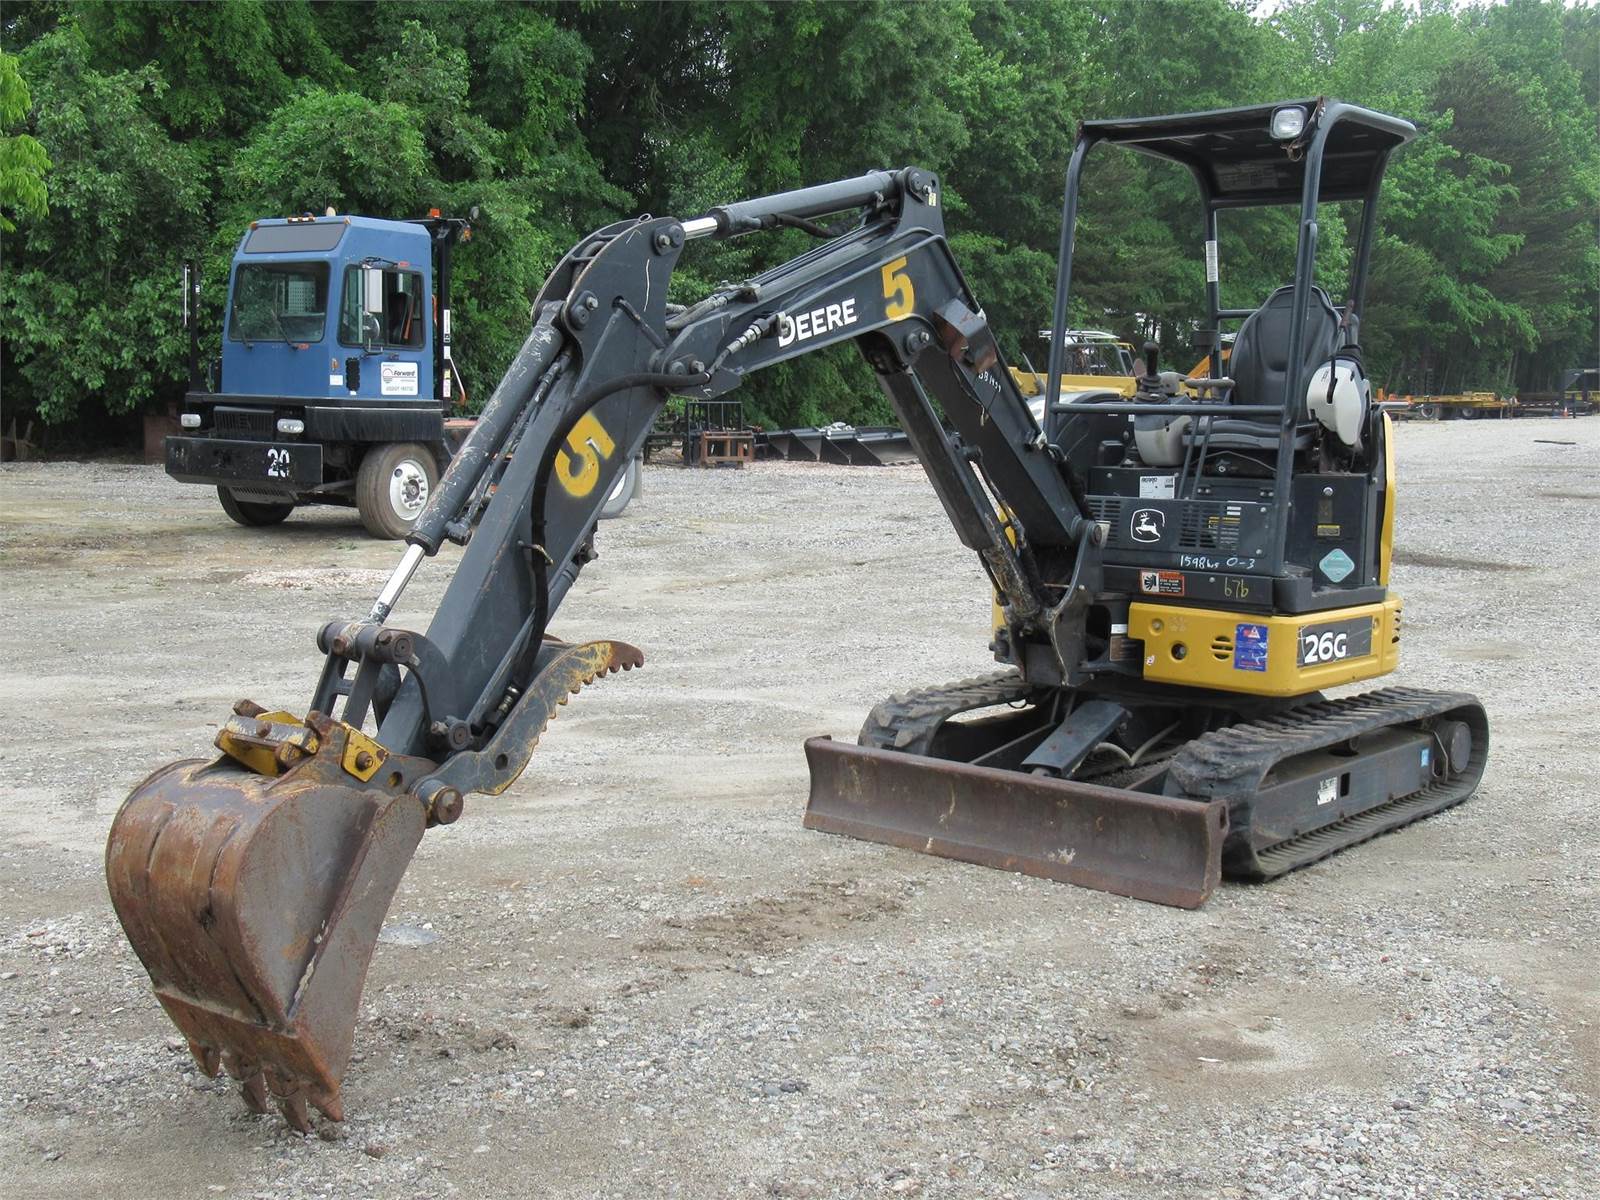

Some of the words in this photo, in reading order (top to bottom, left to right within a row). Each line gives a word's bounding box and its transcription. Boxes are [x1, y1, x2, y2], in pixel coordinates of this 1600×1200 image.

[881, 256, 915, 321] 5
[778, 298, 858, 348] DEERE
[554, 410, 616, 498] 5
[1304, 632, 1347, 663] 26G
